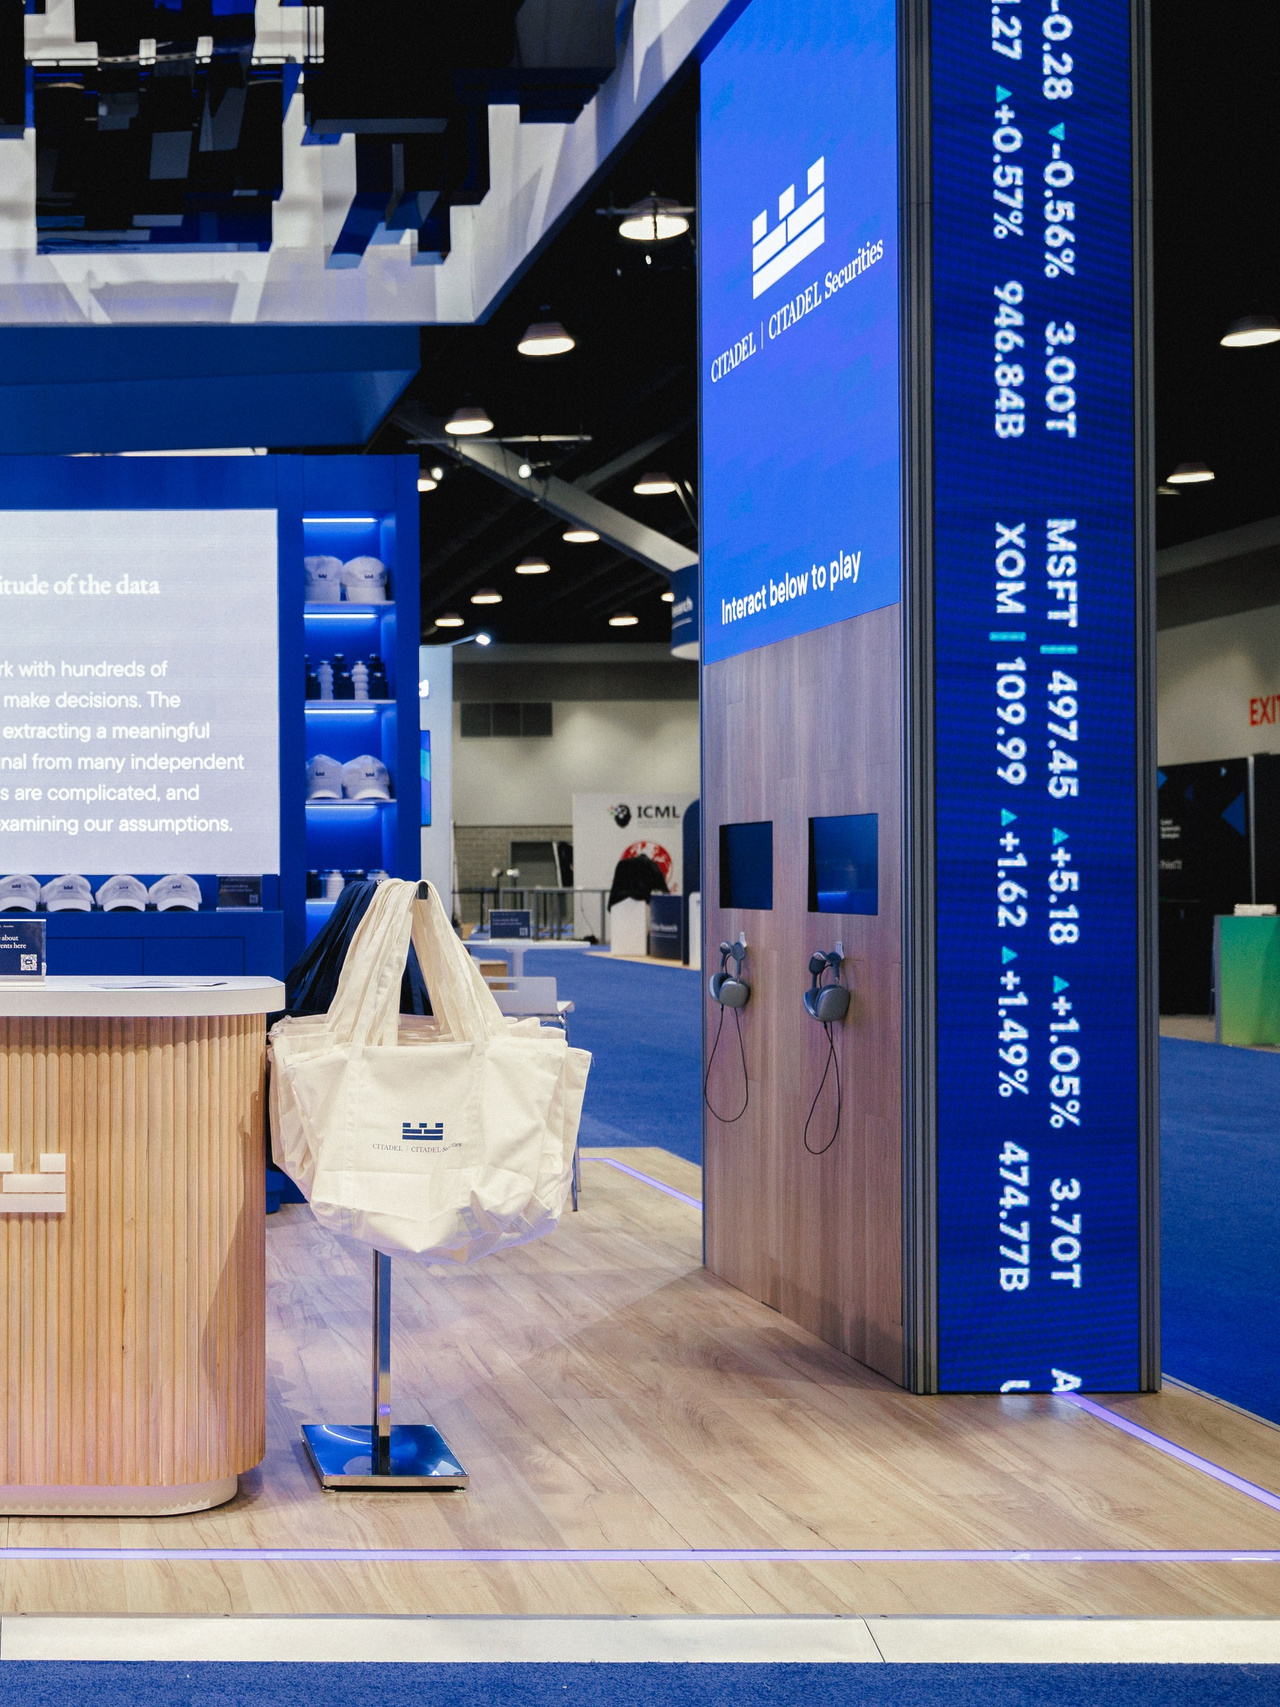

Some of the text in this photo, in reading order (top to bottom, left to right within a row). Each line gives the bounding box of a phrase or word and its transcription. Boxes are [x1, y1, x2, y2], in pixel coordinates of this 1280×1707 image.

[992, 104, 1024, 240] +0.57%
[1043, 143, 1075, 279] -0.56%
[710, 239, 884, 384] CITADEL CITADEL Securities
[993, 280, 1025, 440] 946.84B
[1045, 321, 1077, 439] 3.00T
[53, 573, 78, 595] of
[79, 573, 111, 595] the
[116, 573, 160, 595] data
[721, 584, 767, 625] Interact
[770, 572, 809, 607] below
[811, 563, 827, 591] to
[830, 549, 862, 592] play
[995, 522, 1026, 615] XOM
[1046, 519, 1078, 629] MSFT
[3, 691, 50, 708] make
[55, 691, 142, 708] decisions.
[147, 691, 181, 708] The
[18, 660, 55, 678] with
[61, 660, 145, 678] hundreds
[150, 660, 168, 678] of
[2, 722, 91, 742] extracting
[96, 725, 107, 739] a
[112, 722, 210, 742] meaningful
[32, 753, 71, 770] from
[77, 757, 126, 774] many
[131, 753, 245, 773] independent
[996, 657, 1027, 786] 109.99
[1047, 670, 1078, 800] 497.45
[14, 787, 42, 801] are
[47, 784, 161, 804] complicated,
[166, 784, 200, 801] and
[84, 818, 114, 832] our
[118, 815, 233, 836] assumptions.
[637, 805, 681, 819] ICML
[997, 832, 1028, 928] +1.62
[1048, 847, 1079, 946] +5.18
[997, 971, 1029, 1098] +1.49%
[1049, 996, 1081, 1130] +1.05%
[372, 1143, 403, 1152] CITADEL
[998, 1141, 1030, 1292] 474.77B
[1050, 1178, 1081, 1289] 3.70T
